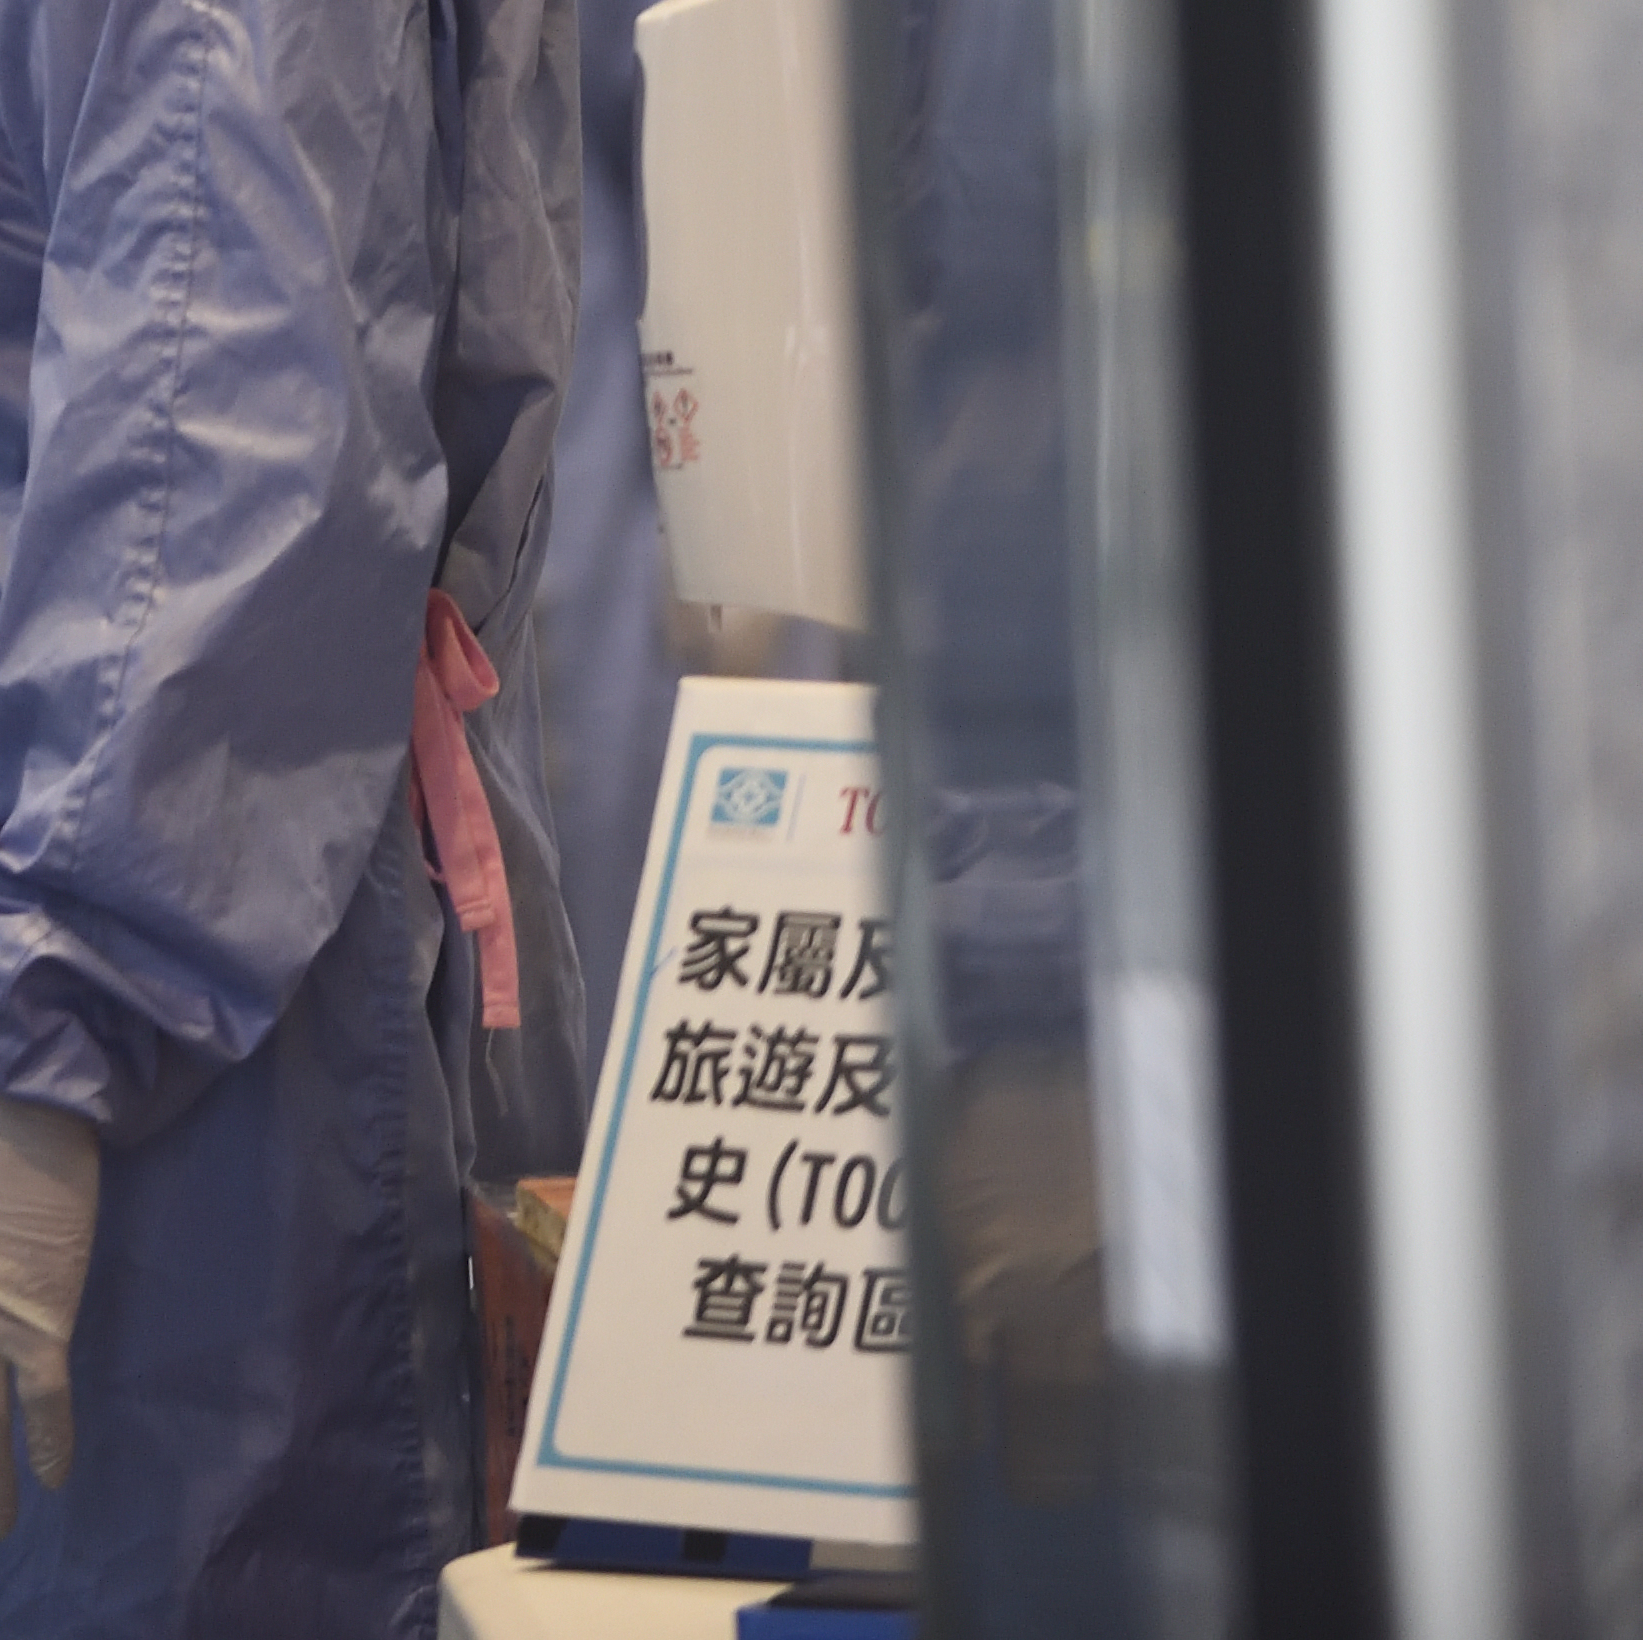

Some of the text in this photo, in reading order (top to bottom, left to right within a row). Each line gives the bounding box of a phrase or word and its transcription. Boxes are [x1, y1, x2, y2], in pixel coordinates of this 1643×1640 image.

[651, 1018, 899, 1118] 旅遊及
[682, 1253, 912, 1353] 查詢區
